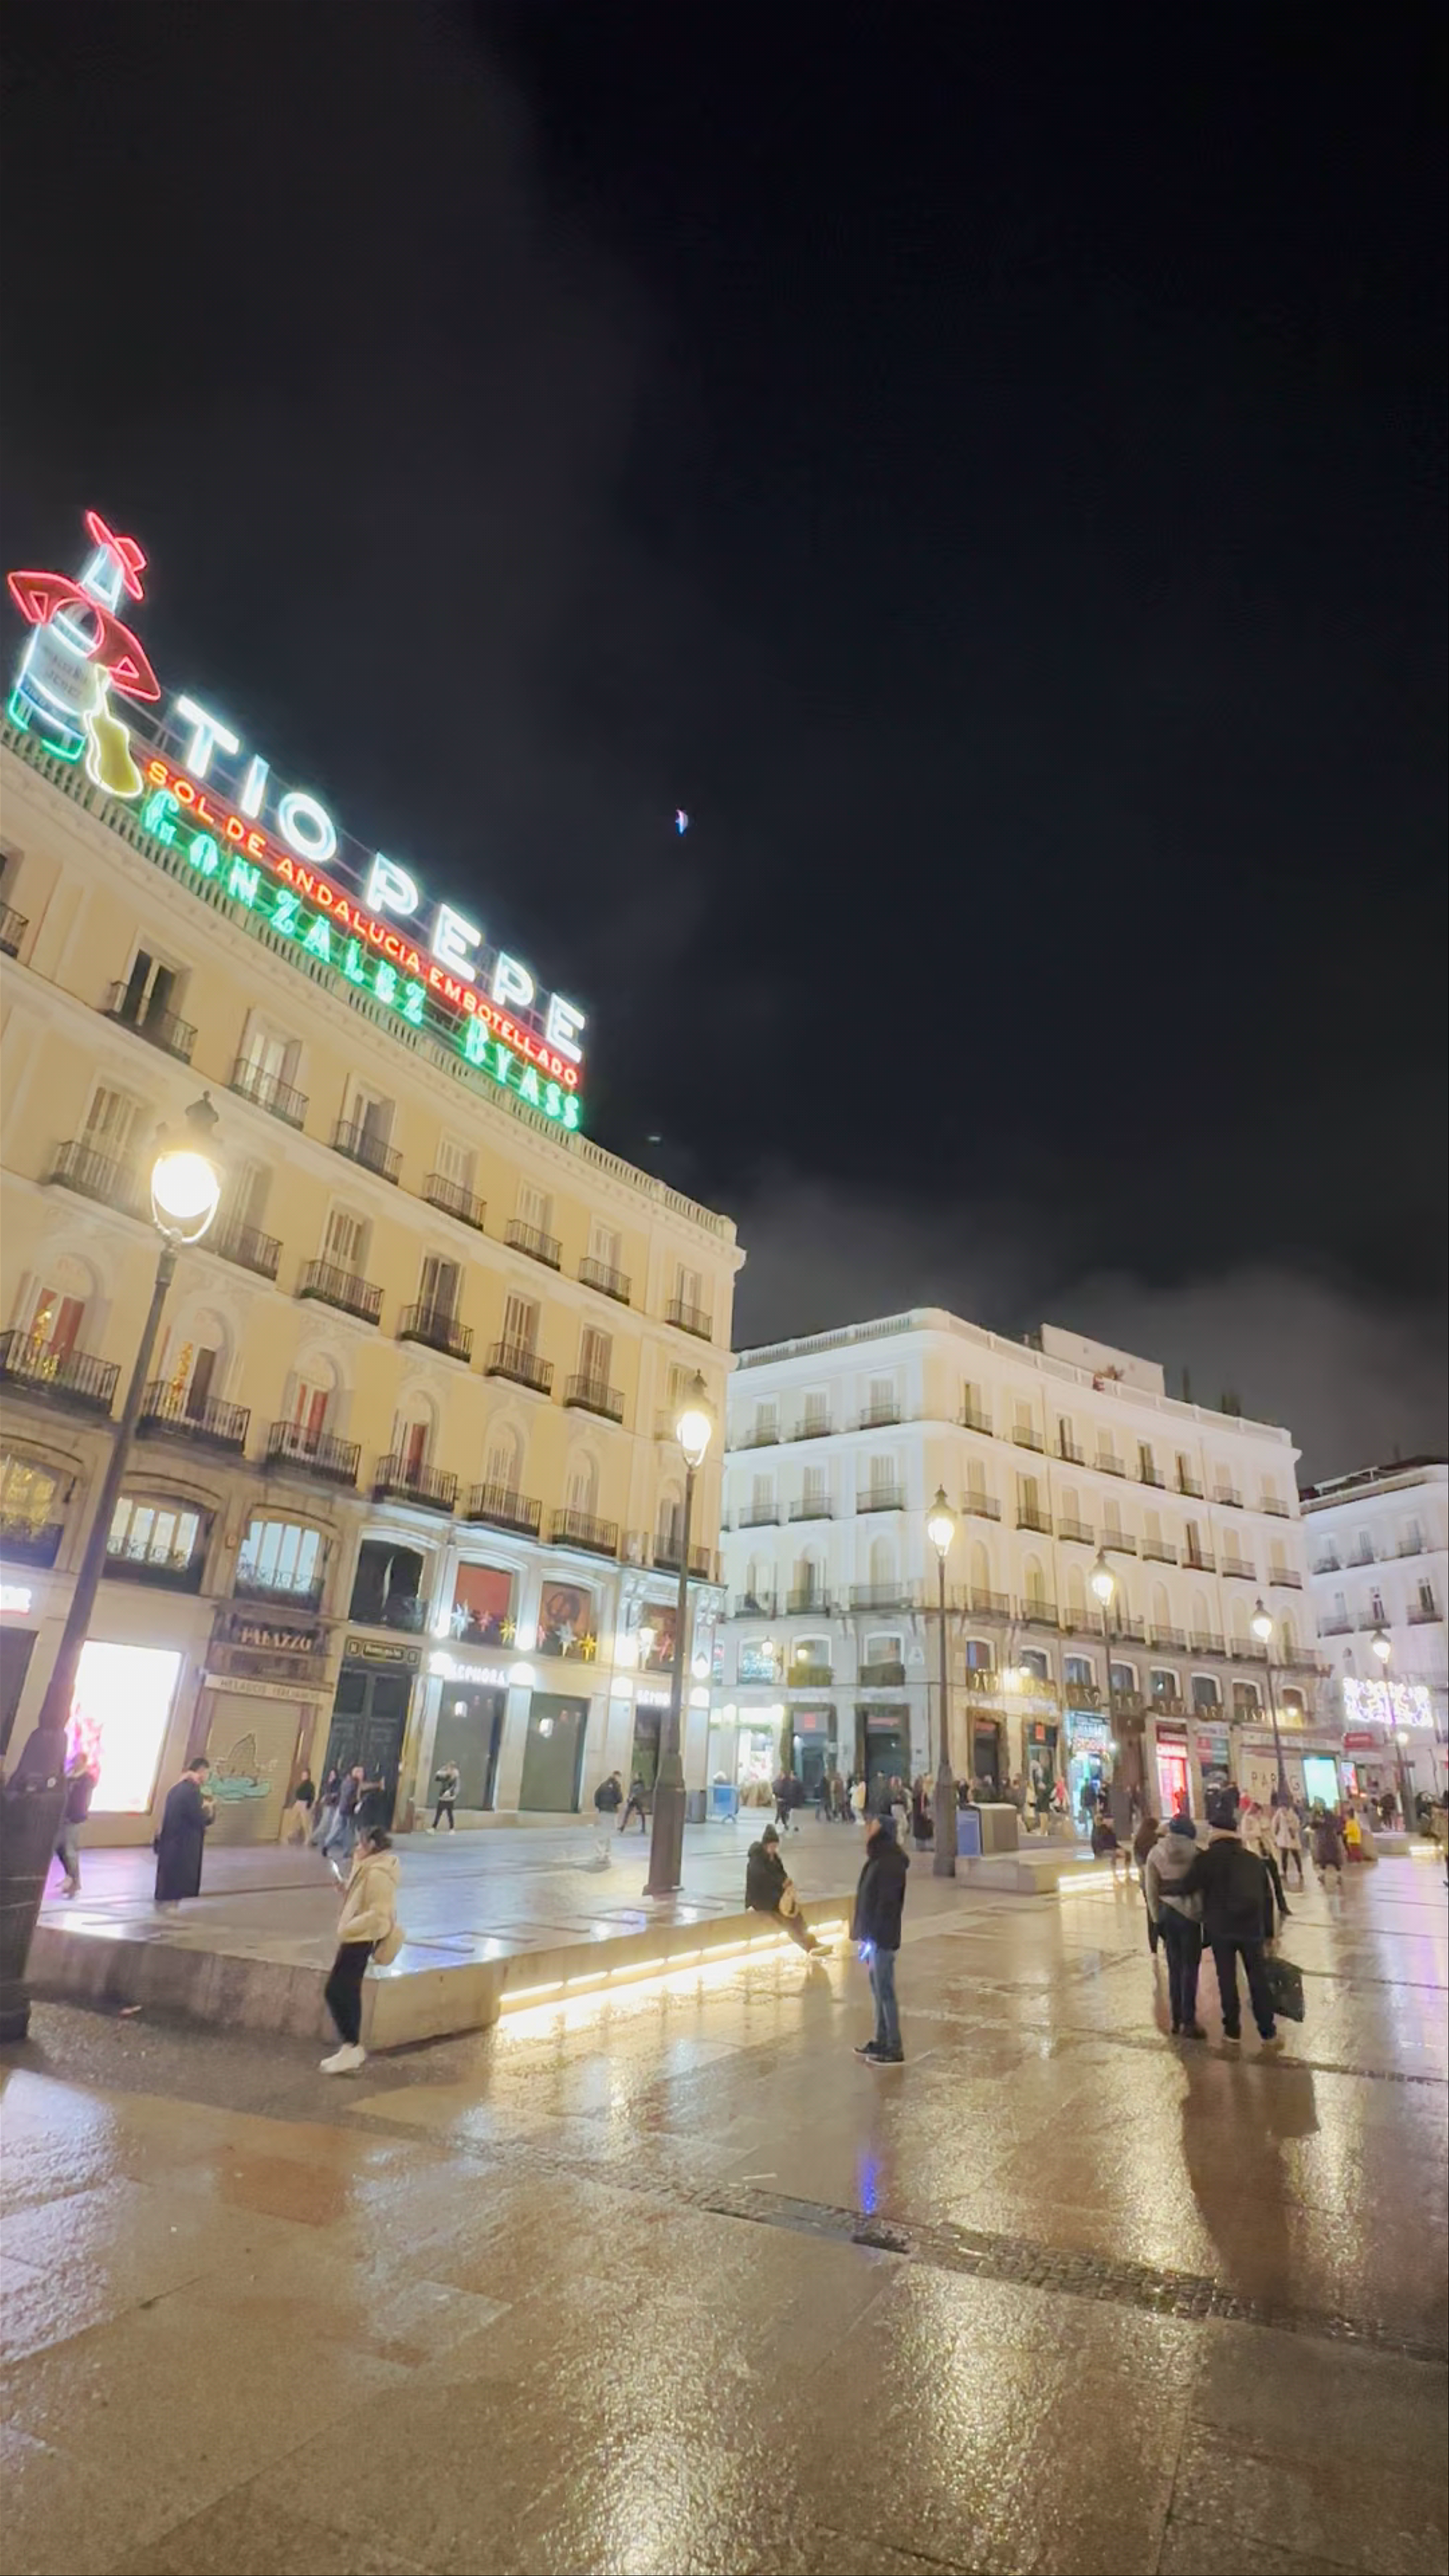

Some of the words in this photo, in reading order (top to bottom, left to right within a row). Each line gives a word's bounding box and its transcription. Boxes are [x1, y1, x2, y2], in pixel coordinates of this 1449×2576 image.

[144, 790, 426, 1025] GONZALEZ
[464, 1014, 579, 1129] BYASS
[148, 761, 214, 824] SOL
[226, 816, 266, 858] DE
[277, 857, 420, 973] ANDALUCIA
[429, 967, 578, 1085] EMBOTELLADO
[176, 695, 337, 862] TIO
[366, 851, 586, 1064] PEPE
[240, 1626, 312, 1651] PALAZZO
